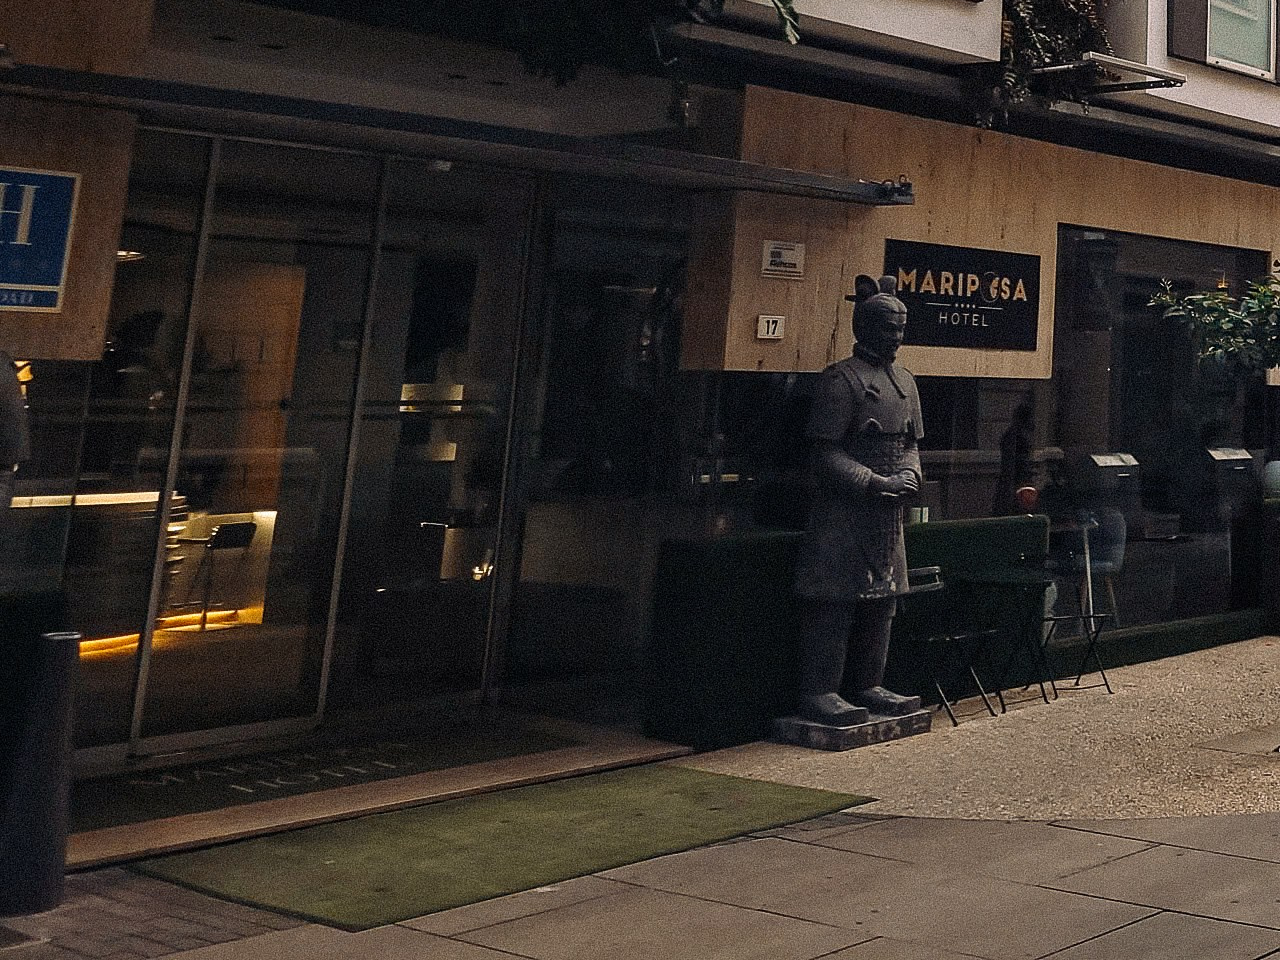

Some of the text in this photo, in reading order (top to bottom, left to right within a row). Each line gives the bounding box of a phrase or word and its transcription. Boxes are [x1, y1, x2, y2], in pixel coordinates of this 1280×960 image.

[0, 182, 41, 246] H
[898, 267, 1028, 302] MARIPOSA
[766, 320, 778, 335] 17
[939, 312, 989, 327] HOTEL
